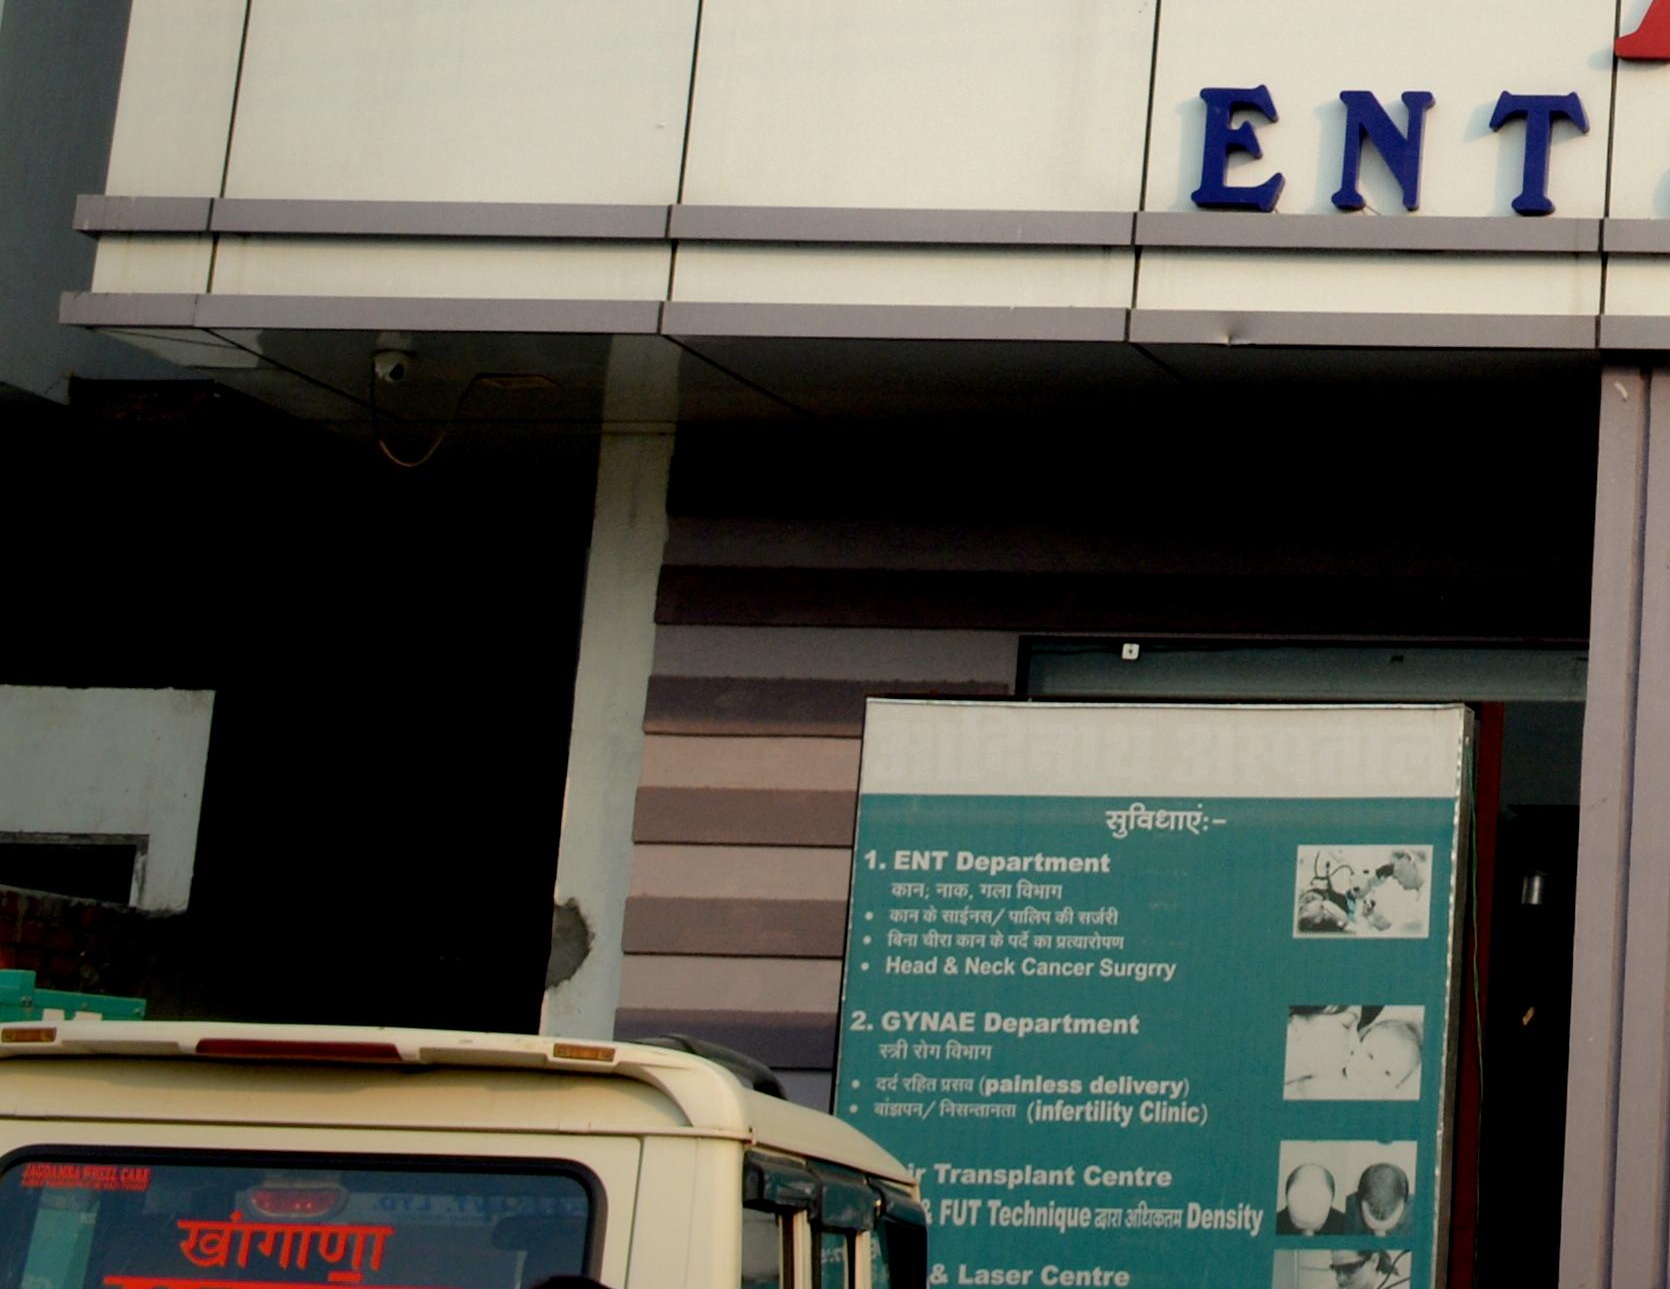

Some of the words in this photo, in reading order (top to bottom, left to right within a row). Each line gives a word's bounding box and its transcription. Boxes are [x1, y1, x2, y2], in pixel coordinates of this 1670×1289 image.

[1190, 83, 1589, 217] ENT
[864, 850, 886, 871] 1.
[894, 850, 949, 871] ENT
[956, 852, 1111, 875] Department
[980, 883, 1012, 899] गला
[1016, 878, 1063, 900] विभाग
[890, 908, 919, 923] कान
[923, 904, 937, 923] के
[1055, 906, 1074, 925] की
[1078, 906, 1119, 926] सर्जरी
[887, 928, 918, 947] बिना
[922, 928, 952, 948] चीरा
[956, 933, 986, 948] कान
[990, 929, 1004, 949] के
[1008, 930, 1031, 949] पर्दे
[1034, 934, 1052, 950] का
[1056, 931, 1125, 951] प्रत्यारोपण
[886, 956, 937, 975] Head
[943, 957, 959, 975] &
[965, 957, 1015, 976] Neck
[1021, 958, 1095, 977] Cancer
[1100, 959, 1177, 982] Surgrry
[850, 1010, 873, 1032] 2.
[881, 1011, 976, 1033] GYNAE
[984, 1013, 1140, 1037] Department
[878, 1038, 908, 1060] स्त्री
[913, 1039, 941, 1060] रोग
[945, 1039, 993, 1060] विभाग
[876, 1072, 899, 1091] दर्द
[902, 1073, 937, 1093] रहित
[941, 1077, 974, 1092] प्रसव
[979, 1075, 1082, 1098] (painless
[1090, 1077, 1190, 1099] delivery)
[1027, 1100, 1133, 1128] (infertility
[1139, 1101, 1208, 1126] Clinic)
[934, 1163, 1075, 1189] Transplant
[1084, 1165, 1172, 1187] Centre
[939, 1199, 982, 1227] FUT
[988, 1200, 1091, 1234] Technique
[1187, 1202, 1264, 1237] Density
[929, 1263, 948, 1285] &
[957, 1264, 1033, 1286] Laser
[1041, 1265, 1131, 1288] Centre
